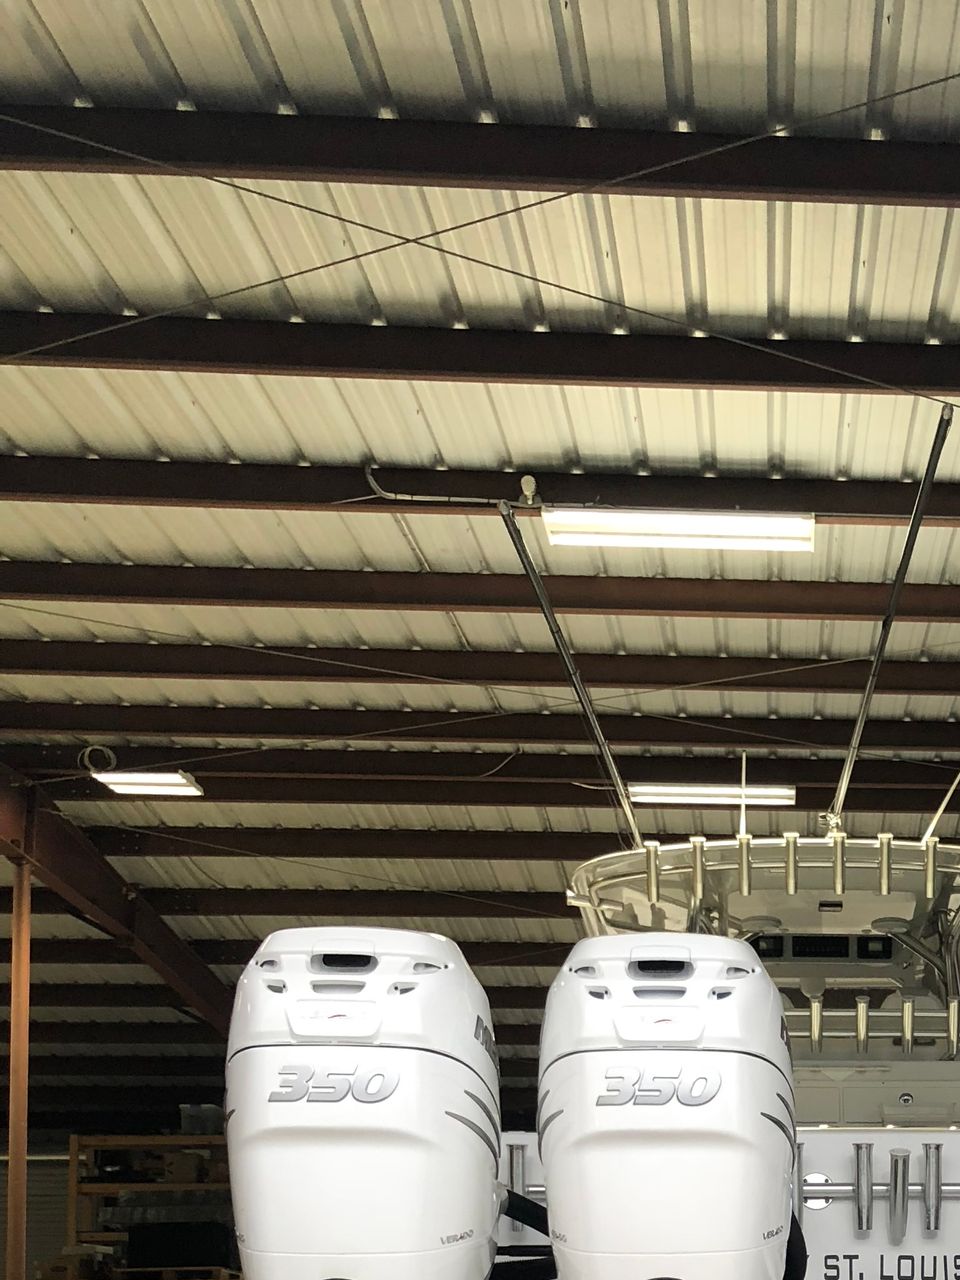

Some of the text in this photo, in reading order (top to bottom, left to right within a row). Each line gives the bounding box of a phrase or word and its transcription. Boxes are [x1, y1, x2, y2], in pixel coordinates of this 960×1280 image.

[268, 1063, 400, 1104] 350
[596, 1065, 722, 1107] 350
[823, 1254, 864, 1280] ST.
